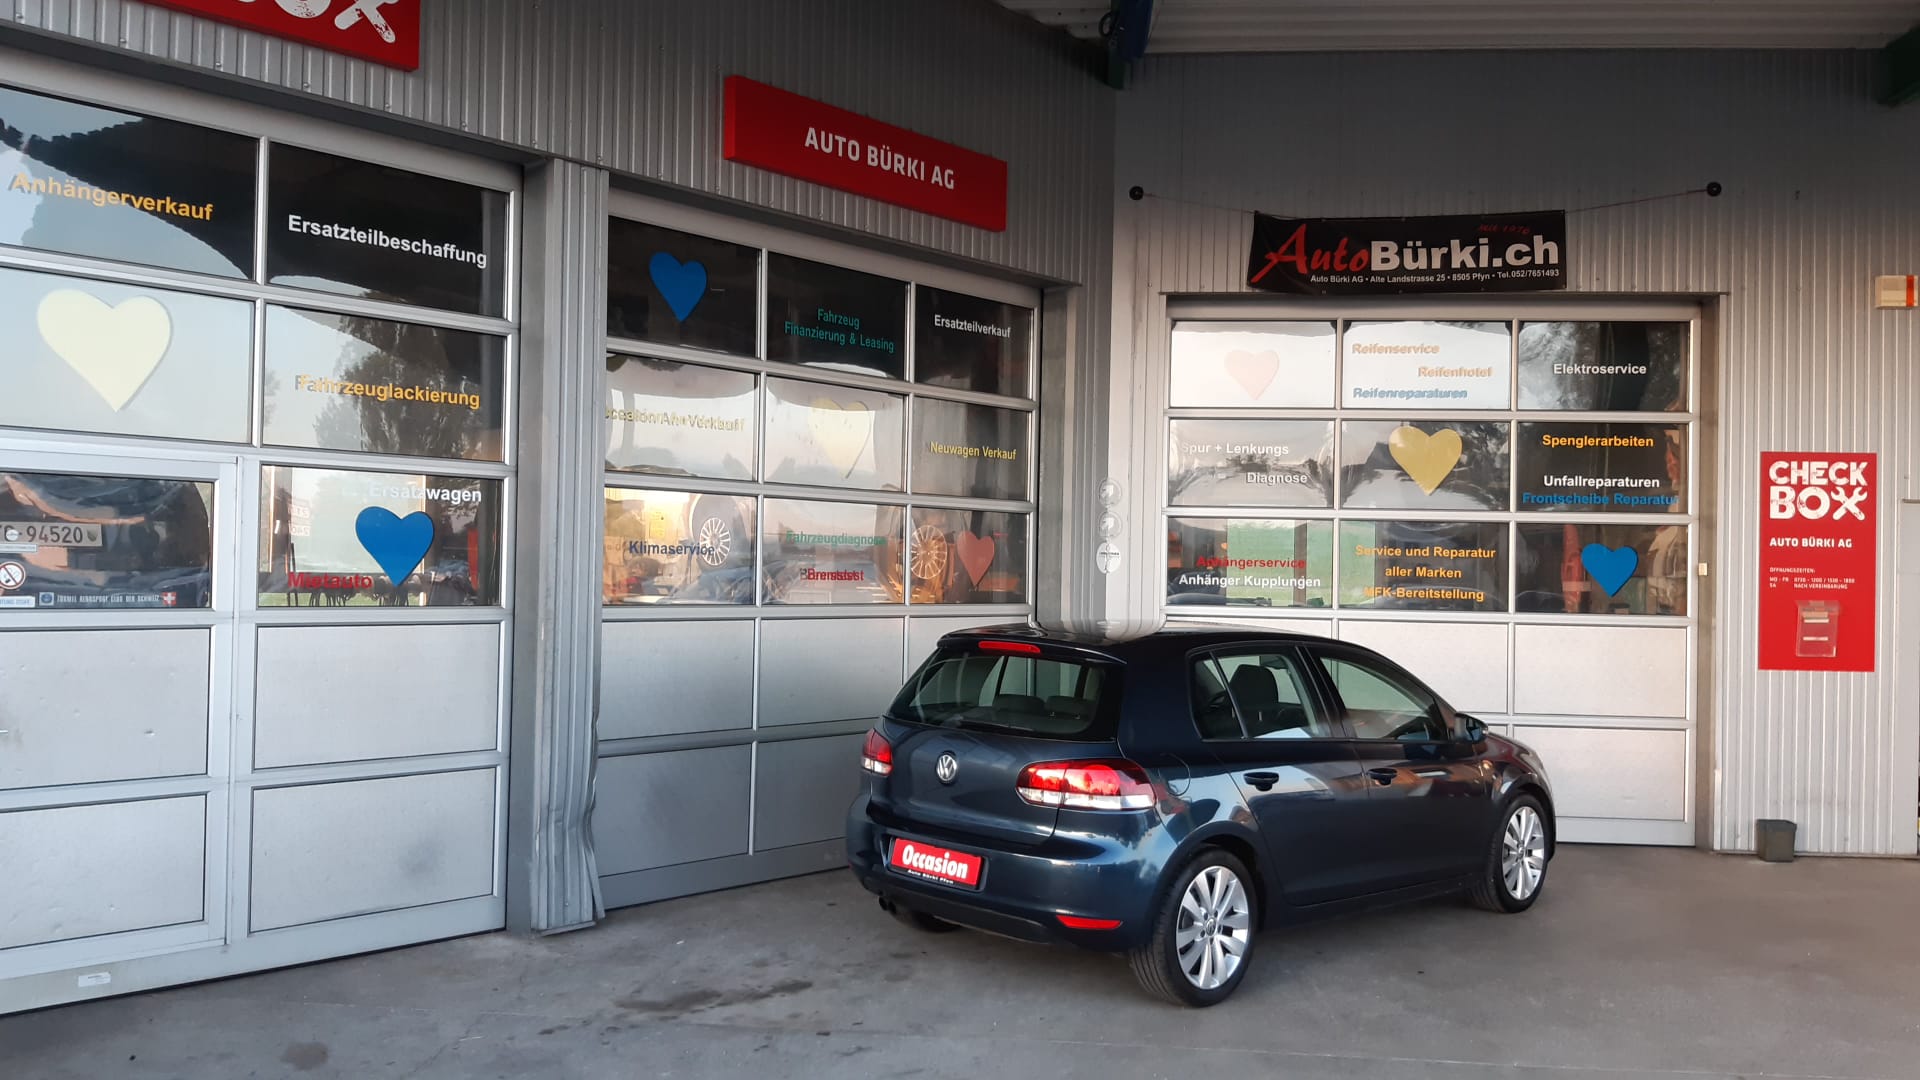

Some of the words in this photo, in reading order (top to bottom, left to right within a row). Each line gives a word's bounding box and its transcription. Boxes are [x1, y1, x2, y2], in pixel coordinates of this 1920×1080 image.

[804, 126, 860, 162] AUTO
[867, 144, 925, 181] BÜRKI
[931, 165, 955, 190] AG
[11, 171, 214, 221] Anhängerverkauf
[288, 214, 487, 269] Ersatzteilbeschaffung
[1310, 275, 1329, 283] Auto
[1330, 275, 1350, 283] Bürki
[1352, 275, 1364, 283] AG
[1370, 275, 1386, 283] Alte
[1387, 274, 1435, 283] Landstrasse
[1436, 273, 1446, 281] 25
[1452, 273, 1471, 281] 8505
[1472, 272, 1490, 282] Pfyn
[817, 308, 860, 331] Fahrzeug
[934, 314, 1011, 339] Ersatzteilverkauf
[784, 321, 846, 346] Finanzierung
[849, 333, 856, 345] &
[860, 335, 895, 354] Leasing
[1352, 342, 1441, 355] Reifenservice
[1418, 366, 1493, 378] Reifenhotel
[1553, 363, 1647, 375] Elektroservice
[296, 373, 482, 411] Fahrzeuglackierung
[1353, 387, 1468, 400] Reifenreparaturen
[1542, 434, 1654, 449] Spenglerarbeiten
[930, 440, 980, 459] Neuwagen
[982, 445, 1017, 460] Verkauf
[1182, 443, 1211, 455] Spur
[1226, 443, 1289, 457] Lenkungs
[1247, 472, 1308, 486] Diagnose
[1769, 461, 1868, 486] CHECK
[1544, 475, 1660, 489] Unfallreparaturen
[368, 481, 482, 504] Ersatzwagen
[1522, 492, 1609, 505] Frontscheibe
[1614, 493, 1680, 507] Reparatur
[1769, 485, 1868, 520] BOX
[26, 525, 83, 544] 94520
[786, 530, 887, 550] Fahrzeugdiagnose
[1769, 537, 1799, 547] AUTO
[1801, 535, 1835, 548] BÜRKI
[1837, 538, 1853, 548] AG
[628, 540, 716, 557] Klimaservice
[1355, 545, 1402, 557] Service
[1406, 546, 1430, 557] und
[1434, 546, 1496, 559] Reparatur
[1196, 555, 1307, 570] Anhängerservice
[1385, 566, 1413, 577] aller
[1415, 567, 1462, 578] Marken
[287, 571, 374, 590] Mietauto
[1179, 575, 1241, 588] Anhänger
[1244, 575, 1321, 589] Kupplungen
[1364, 586, 1485, 602] MFK-Bereitstellung
[902, 844, 969, 879] Occasion
